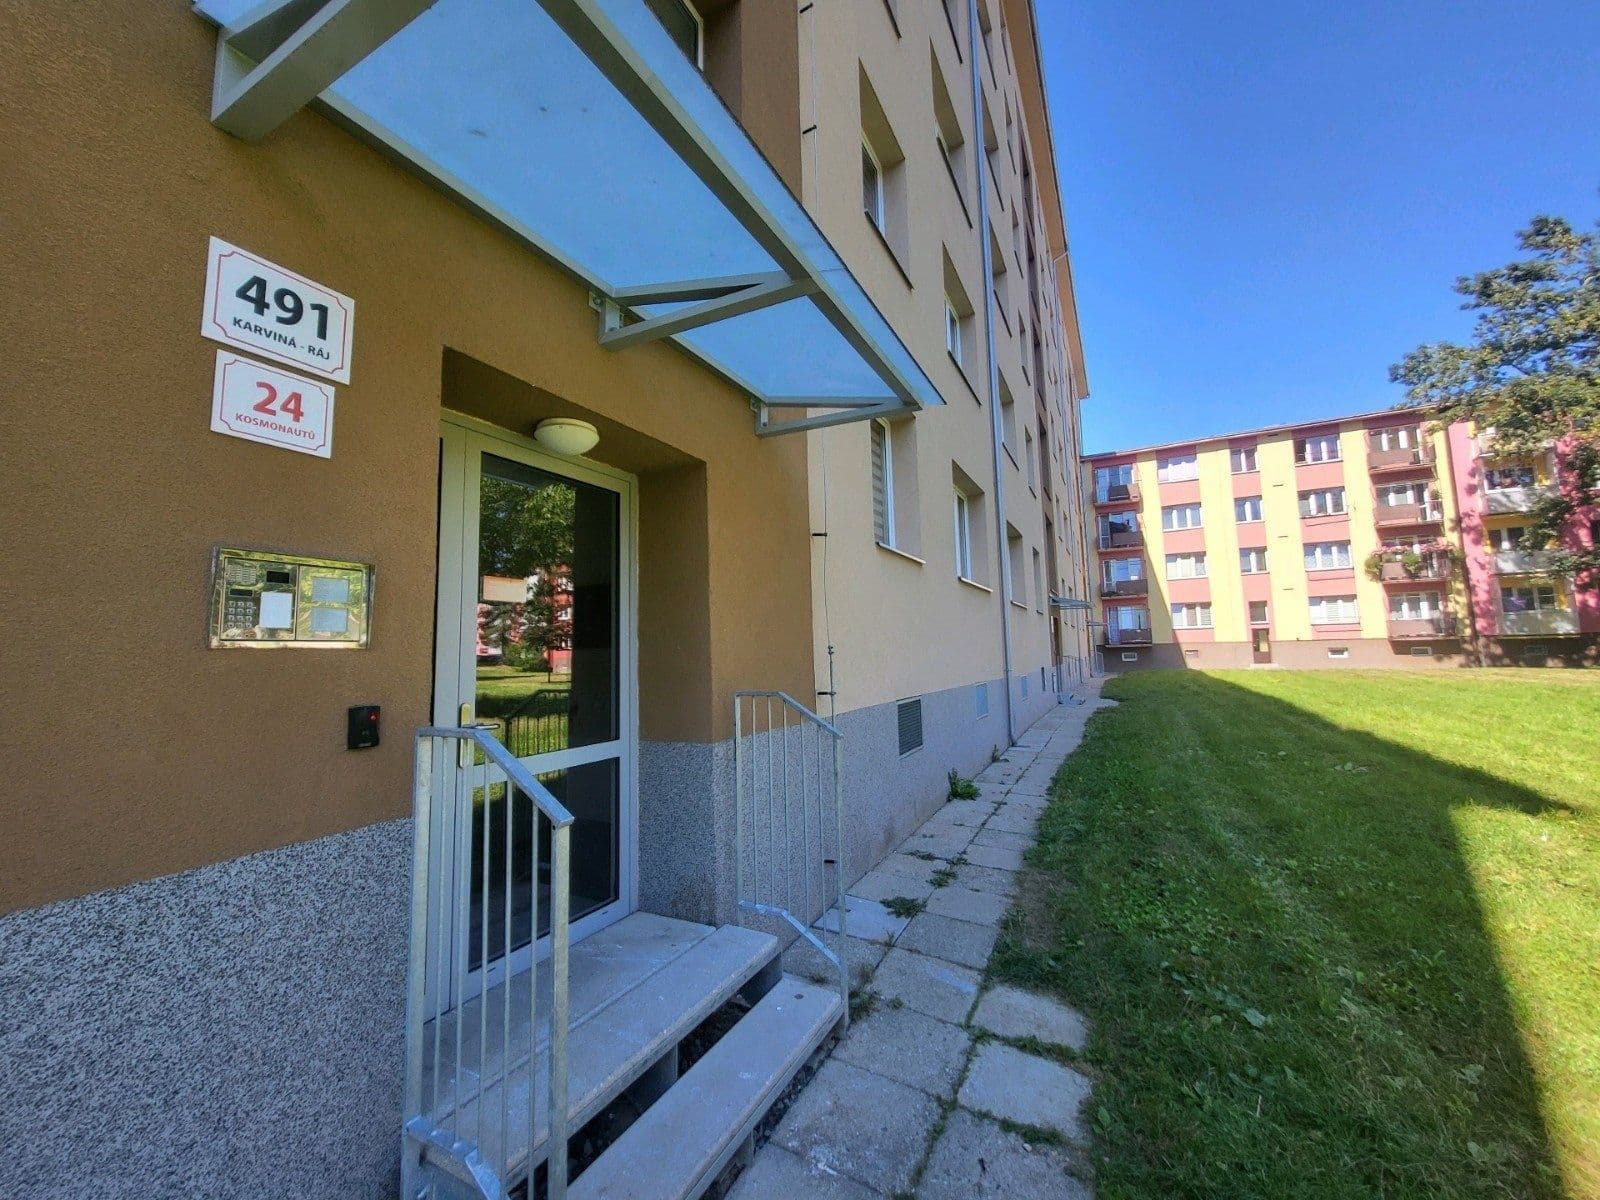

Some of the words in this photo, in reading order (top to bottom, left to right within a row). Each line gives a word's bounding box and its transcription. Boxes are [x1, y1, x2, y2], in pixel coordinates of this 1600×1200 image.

[235, 275, 329, 341] 491
[232, 316, 297, 348] KARVINÁ
[308, 344, 330, 360] RÁJ
[253, 381, 304, 423] 24
[235, 412, 316, 440] KOSMONAUTŮ
